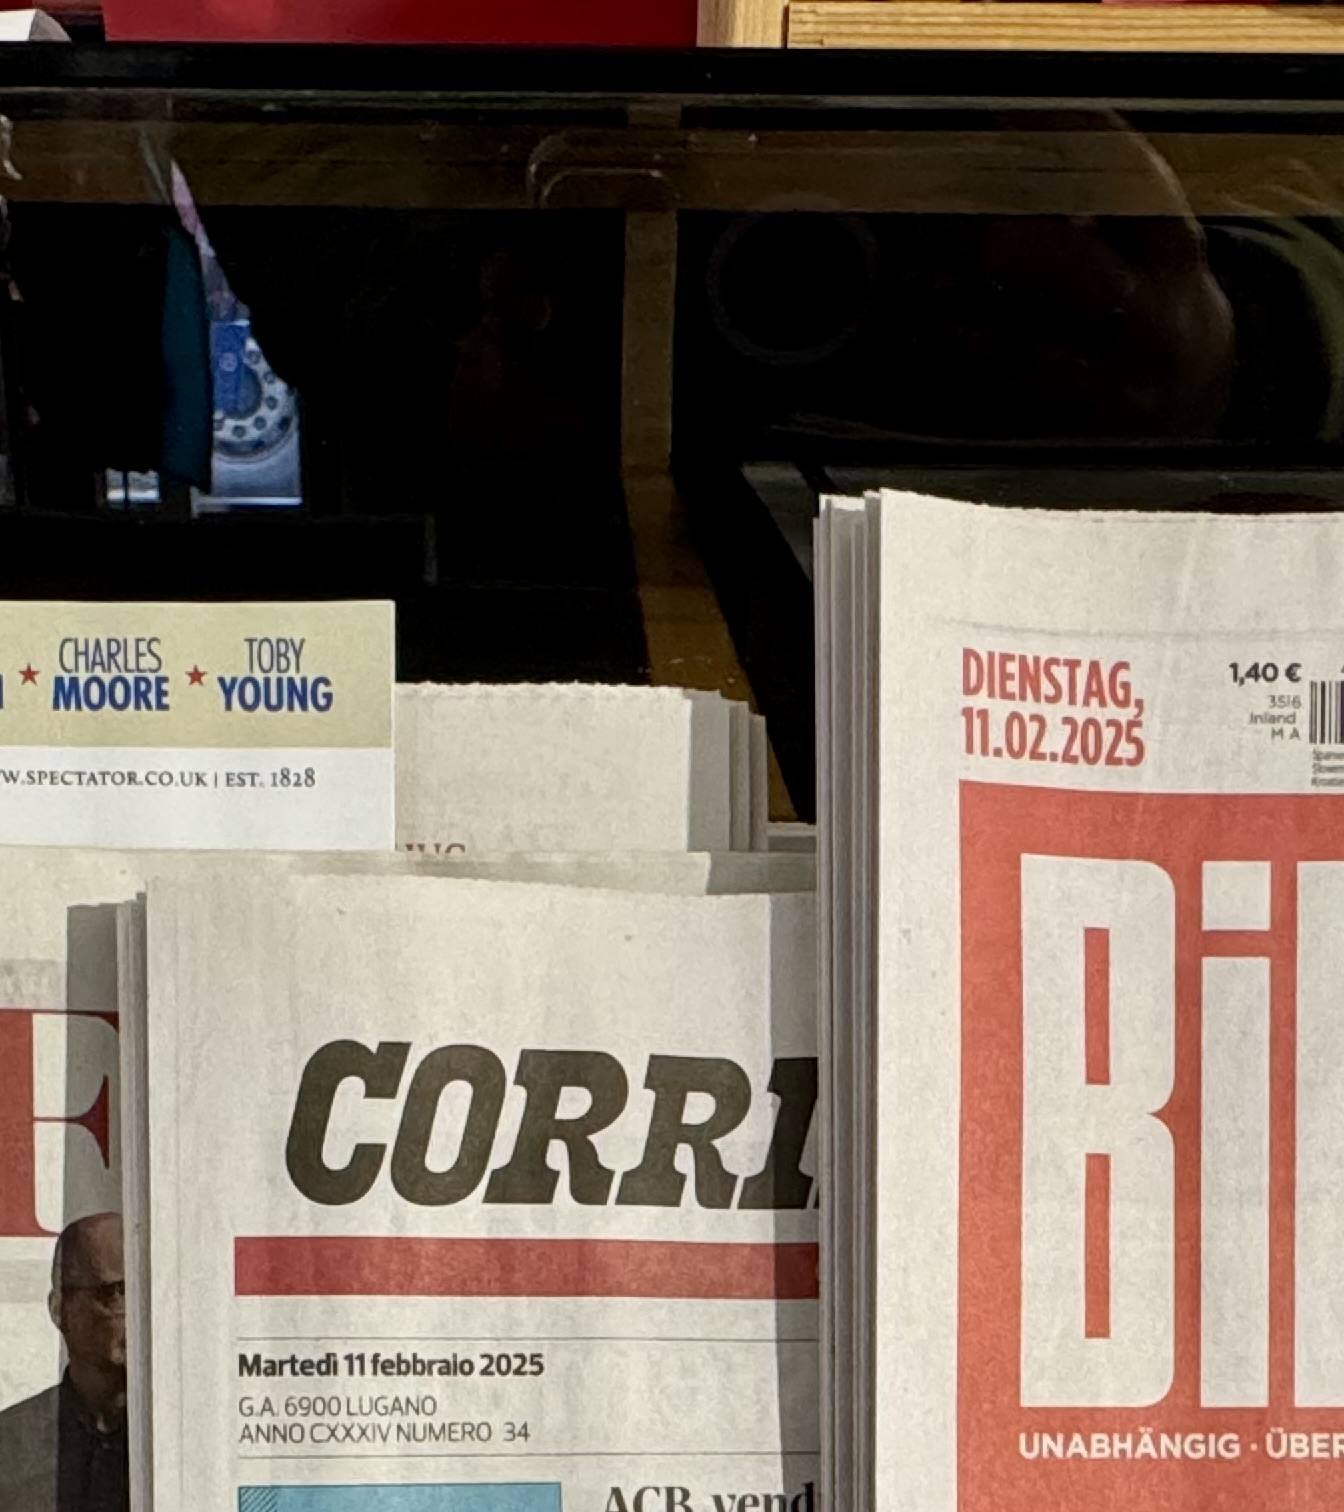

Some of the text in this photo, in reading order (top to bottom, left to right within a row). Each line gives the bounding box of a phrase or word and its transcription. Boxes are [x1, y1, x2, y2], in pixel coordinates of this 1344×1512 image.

[59, 637, 162, 674] CHARLES
[244, 637, 306, 674] TOBY
[960, 647, 1145, 725] DIENSTAG,
[1229, 662, 1302, 687] 1,40 €
[52, 675, 170, 712] MOORE
[217, 676, 333, 713] YOUNG
[961, 701, 1145, 767] 11.02.2025
[225, 772, 264, 788] EST.
[271, 767, 316, 788] 1828
[285, 1039, 820, 1210] CORRI
[238, 1352, 545, 1377] Martedì 11 febbraio 2025
[238, 1394, 437, 1417] G.A. 6900 LUGANO
[238, 1421, 531, 1444] ANNO CXXXIV NUMERO 34
[1018, 1428, 1241, 1460] UNABHÄNGIG
